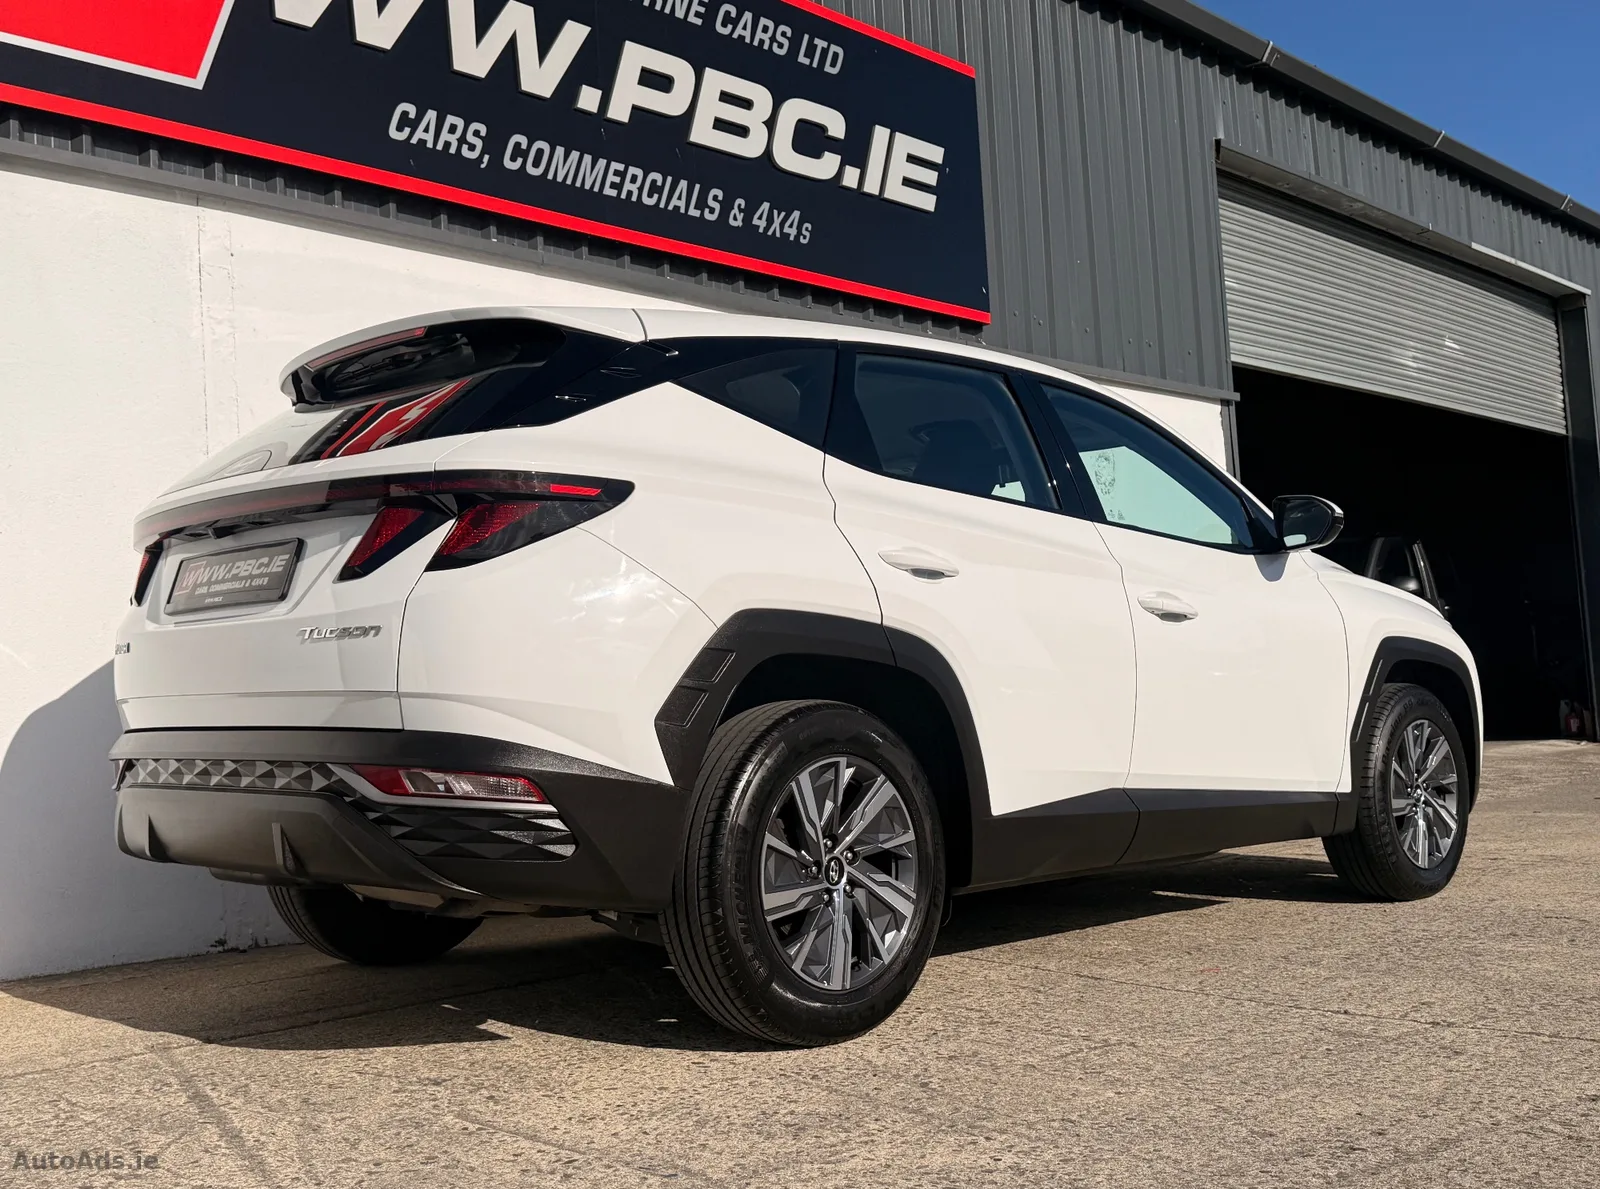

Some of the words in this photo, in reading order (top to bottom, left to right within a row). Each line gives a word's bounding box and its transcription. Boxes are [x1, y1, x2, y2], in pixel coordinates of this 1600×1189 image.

[629, 0, 709, 26] NE
[715, 3, 792, 56] CARS
[797, 33, 844, 75] LTD
[388, 102, 490, 169] CARS,
[502, 133, 724, 222] COMMERCIALS
[728, 197, 746, 228] &
[182, 554, 290, 588] WWW.PBC.IE
